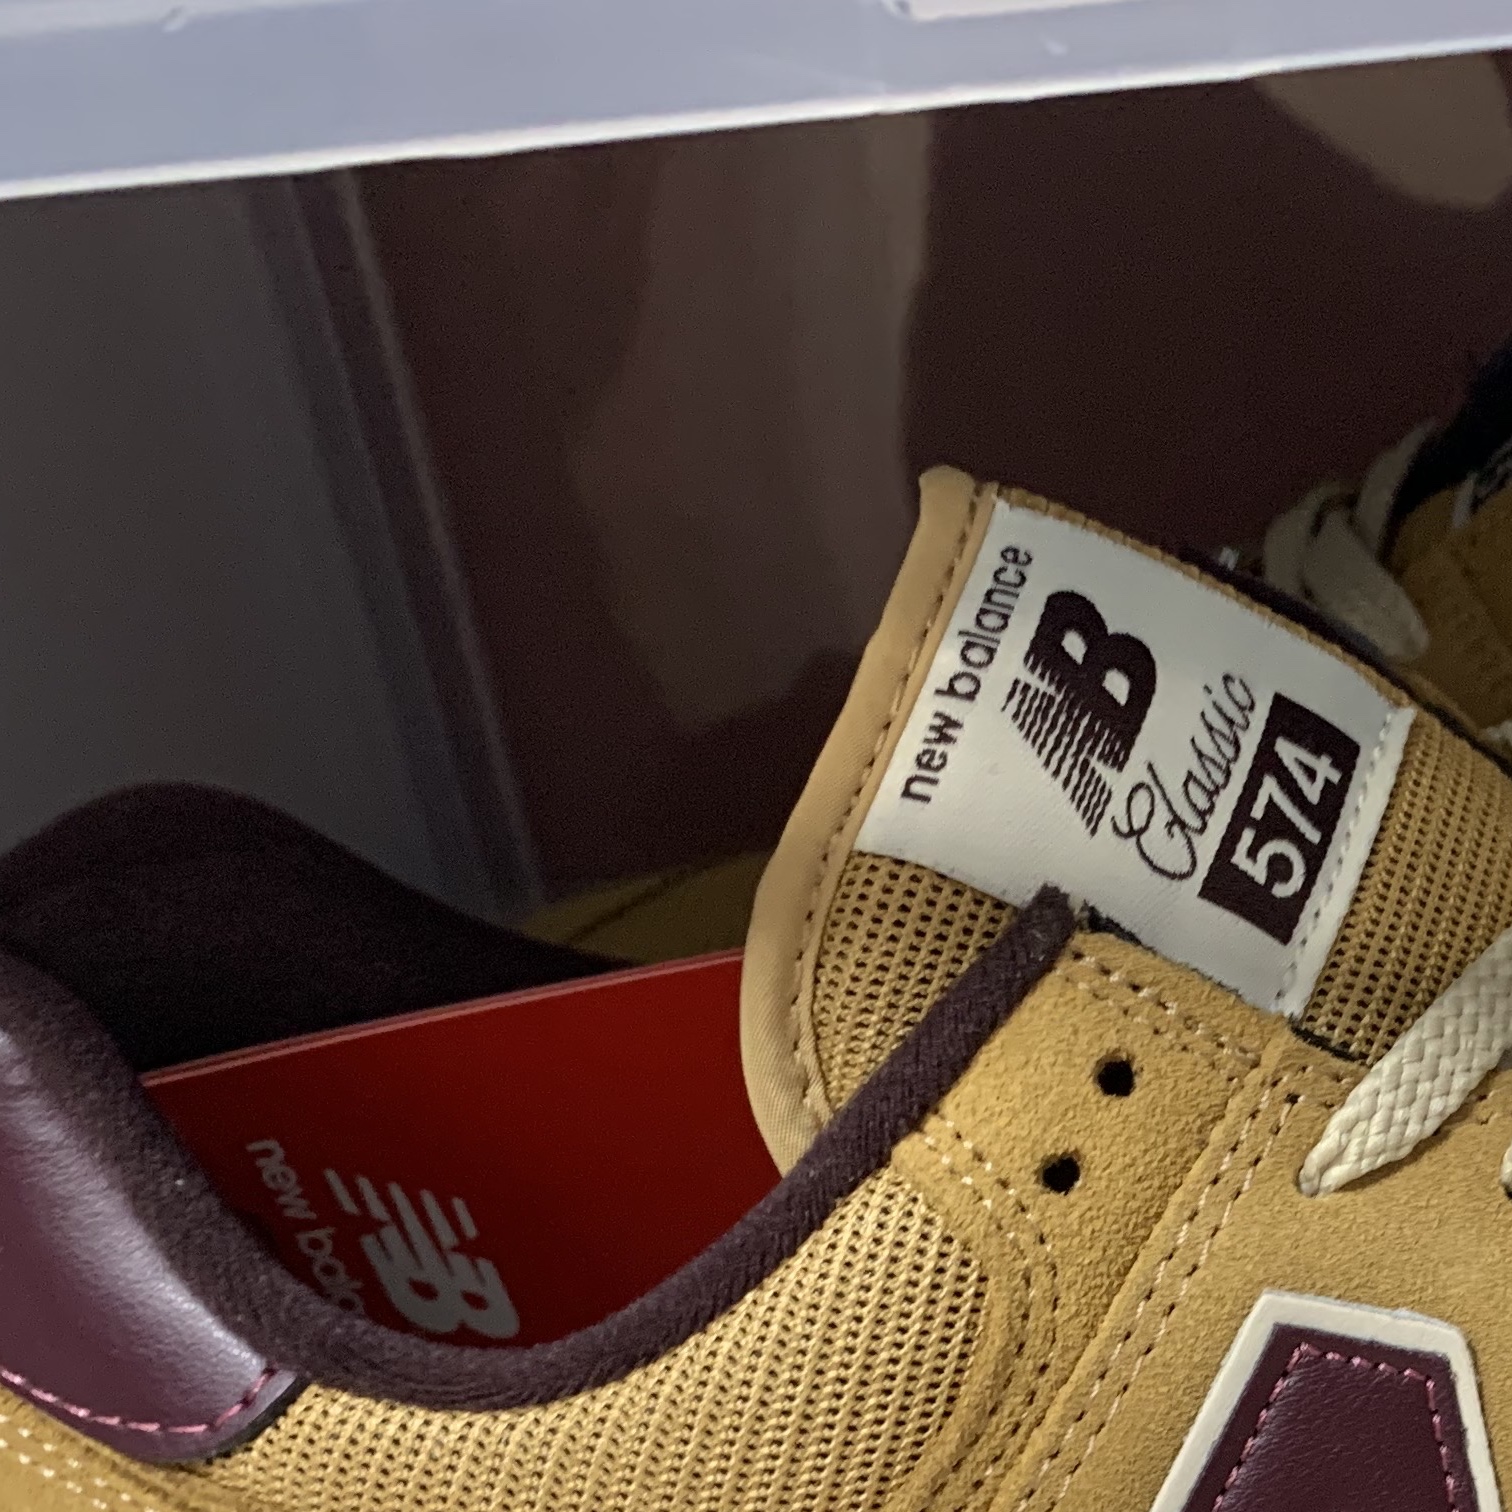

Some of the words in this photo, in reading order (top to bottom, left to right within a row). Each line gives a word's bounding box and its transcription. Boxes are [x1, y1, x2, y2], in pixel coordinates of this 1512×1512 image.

[900, 708, 965, 804] new
[935, 544, 1034, 703] balance
[1111, 672, 1258, 881] Classic
[1230, 736, 1343, 899] 574
[246, 1139, 317, 1220] new
